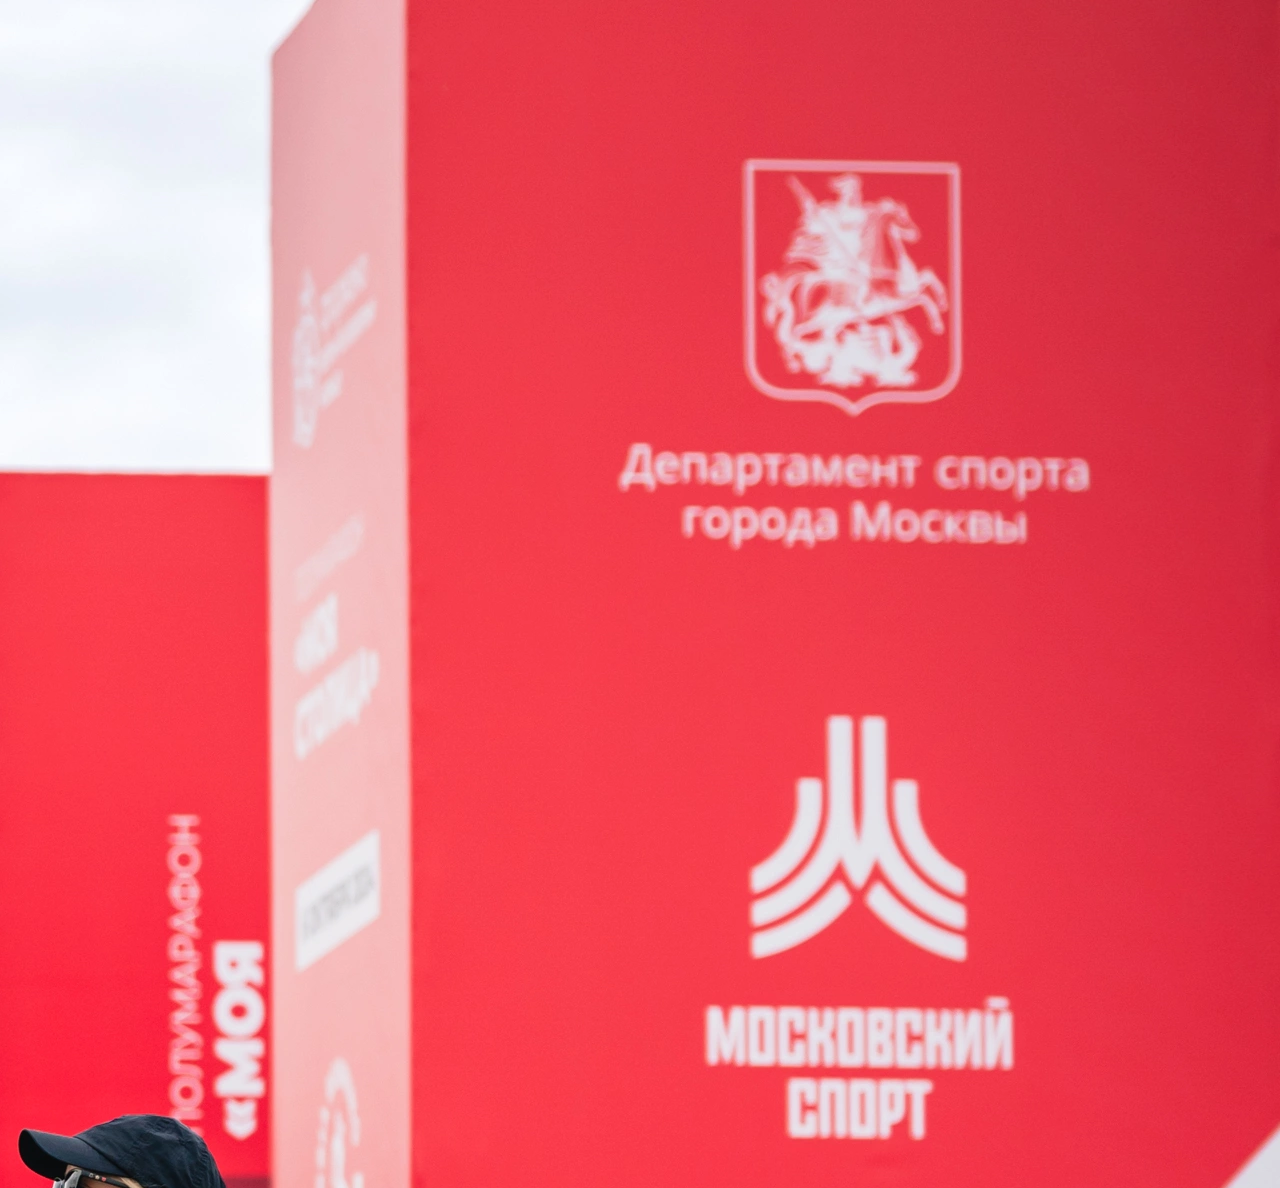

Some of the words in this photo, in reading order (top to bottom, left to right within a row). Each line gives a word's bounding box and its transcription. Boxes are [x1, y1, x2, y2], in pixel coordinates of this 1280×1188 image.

[619, 443, 922, 497] Департамент
[934, 455, 1091, 500] спорта
[681, 503, 840, 550] города
[850, 500, 1028, 545] Москвы
[212, 939, 266, 1140] «МОЯ
[705, 996, 1014, 1070] МОСКОВСКИЙ
[786, 1076, 933, 1140] СПОРТ
